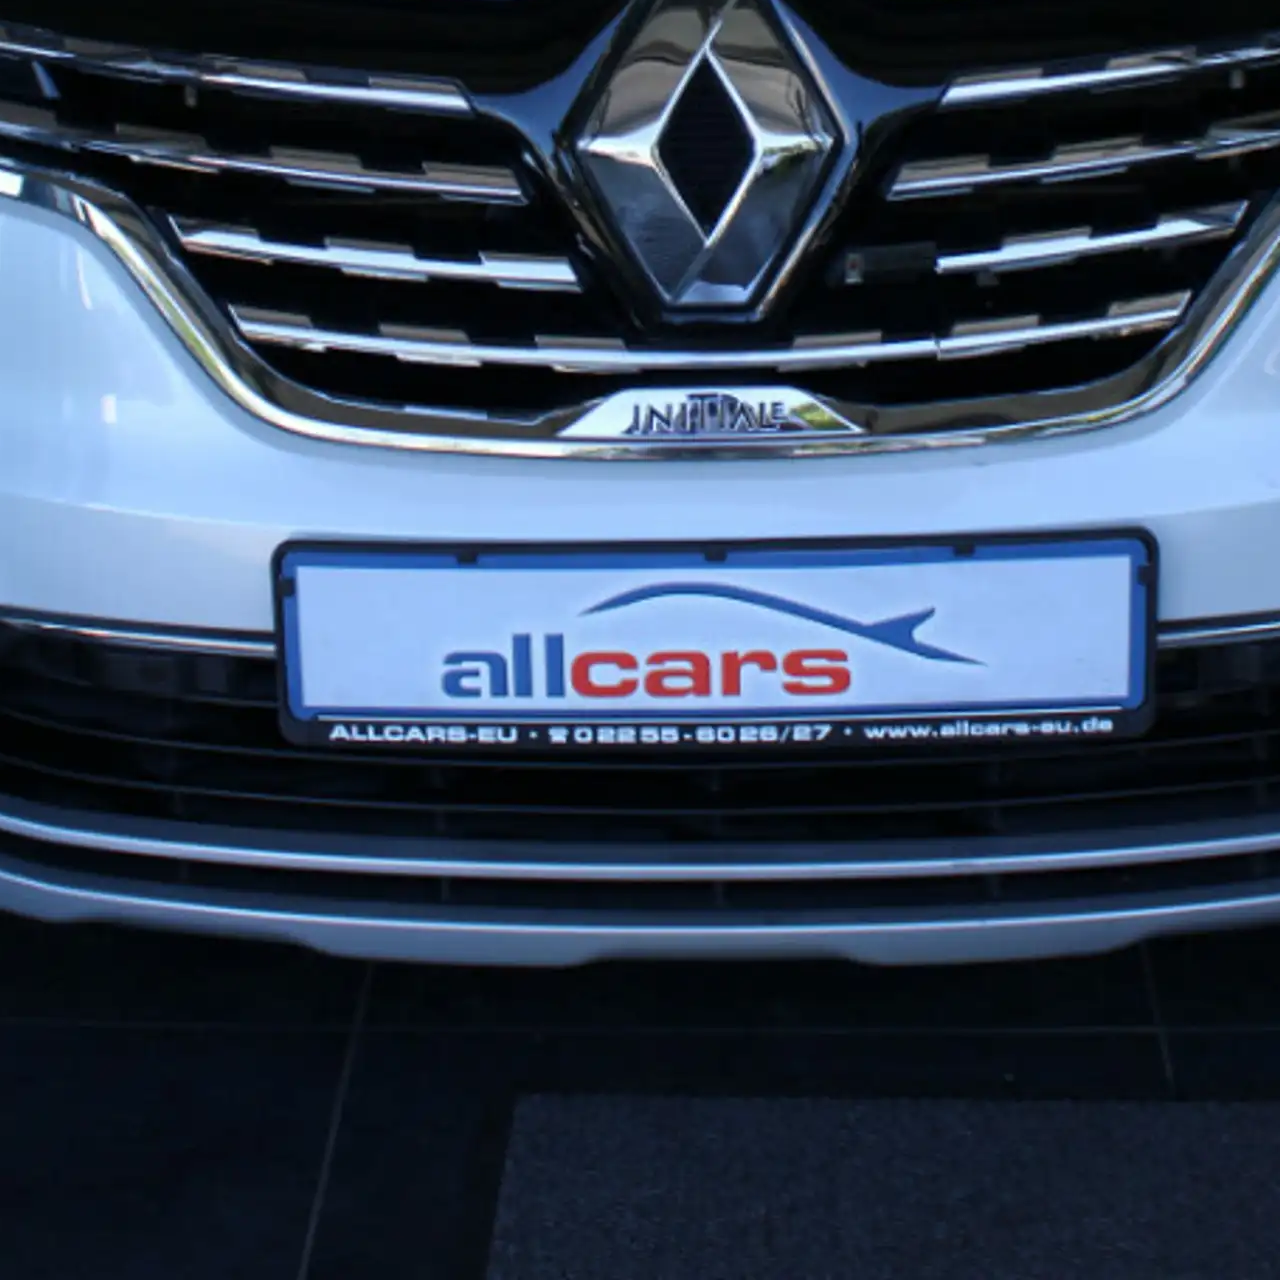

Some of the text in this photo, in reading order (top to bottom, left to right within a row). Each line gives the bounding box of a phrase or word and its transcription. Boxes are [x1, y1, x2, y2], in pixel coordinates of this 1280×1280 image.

[441, 632, 851, 698] allcars
[328, 724, 519, 743] ALLCARS-EU
[863, 717, 1113, 739] www.allcars-eu.de
